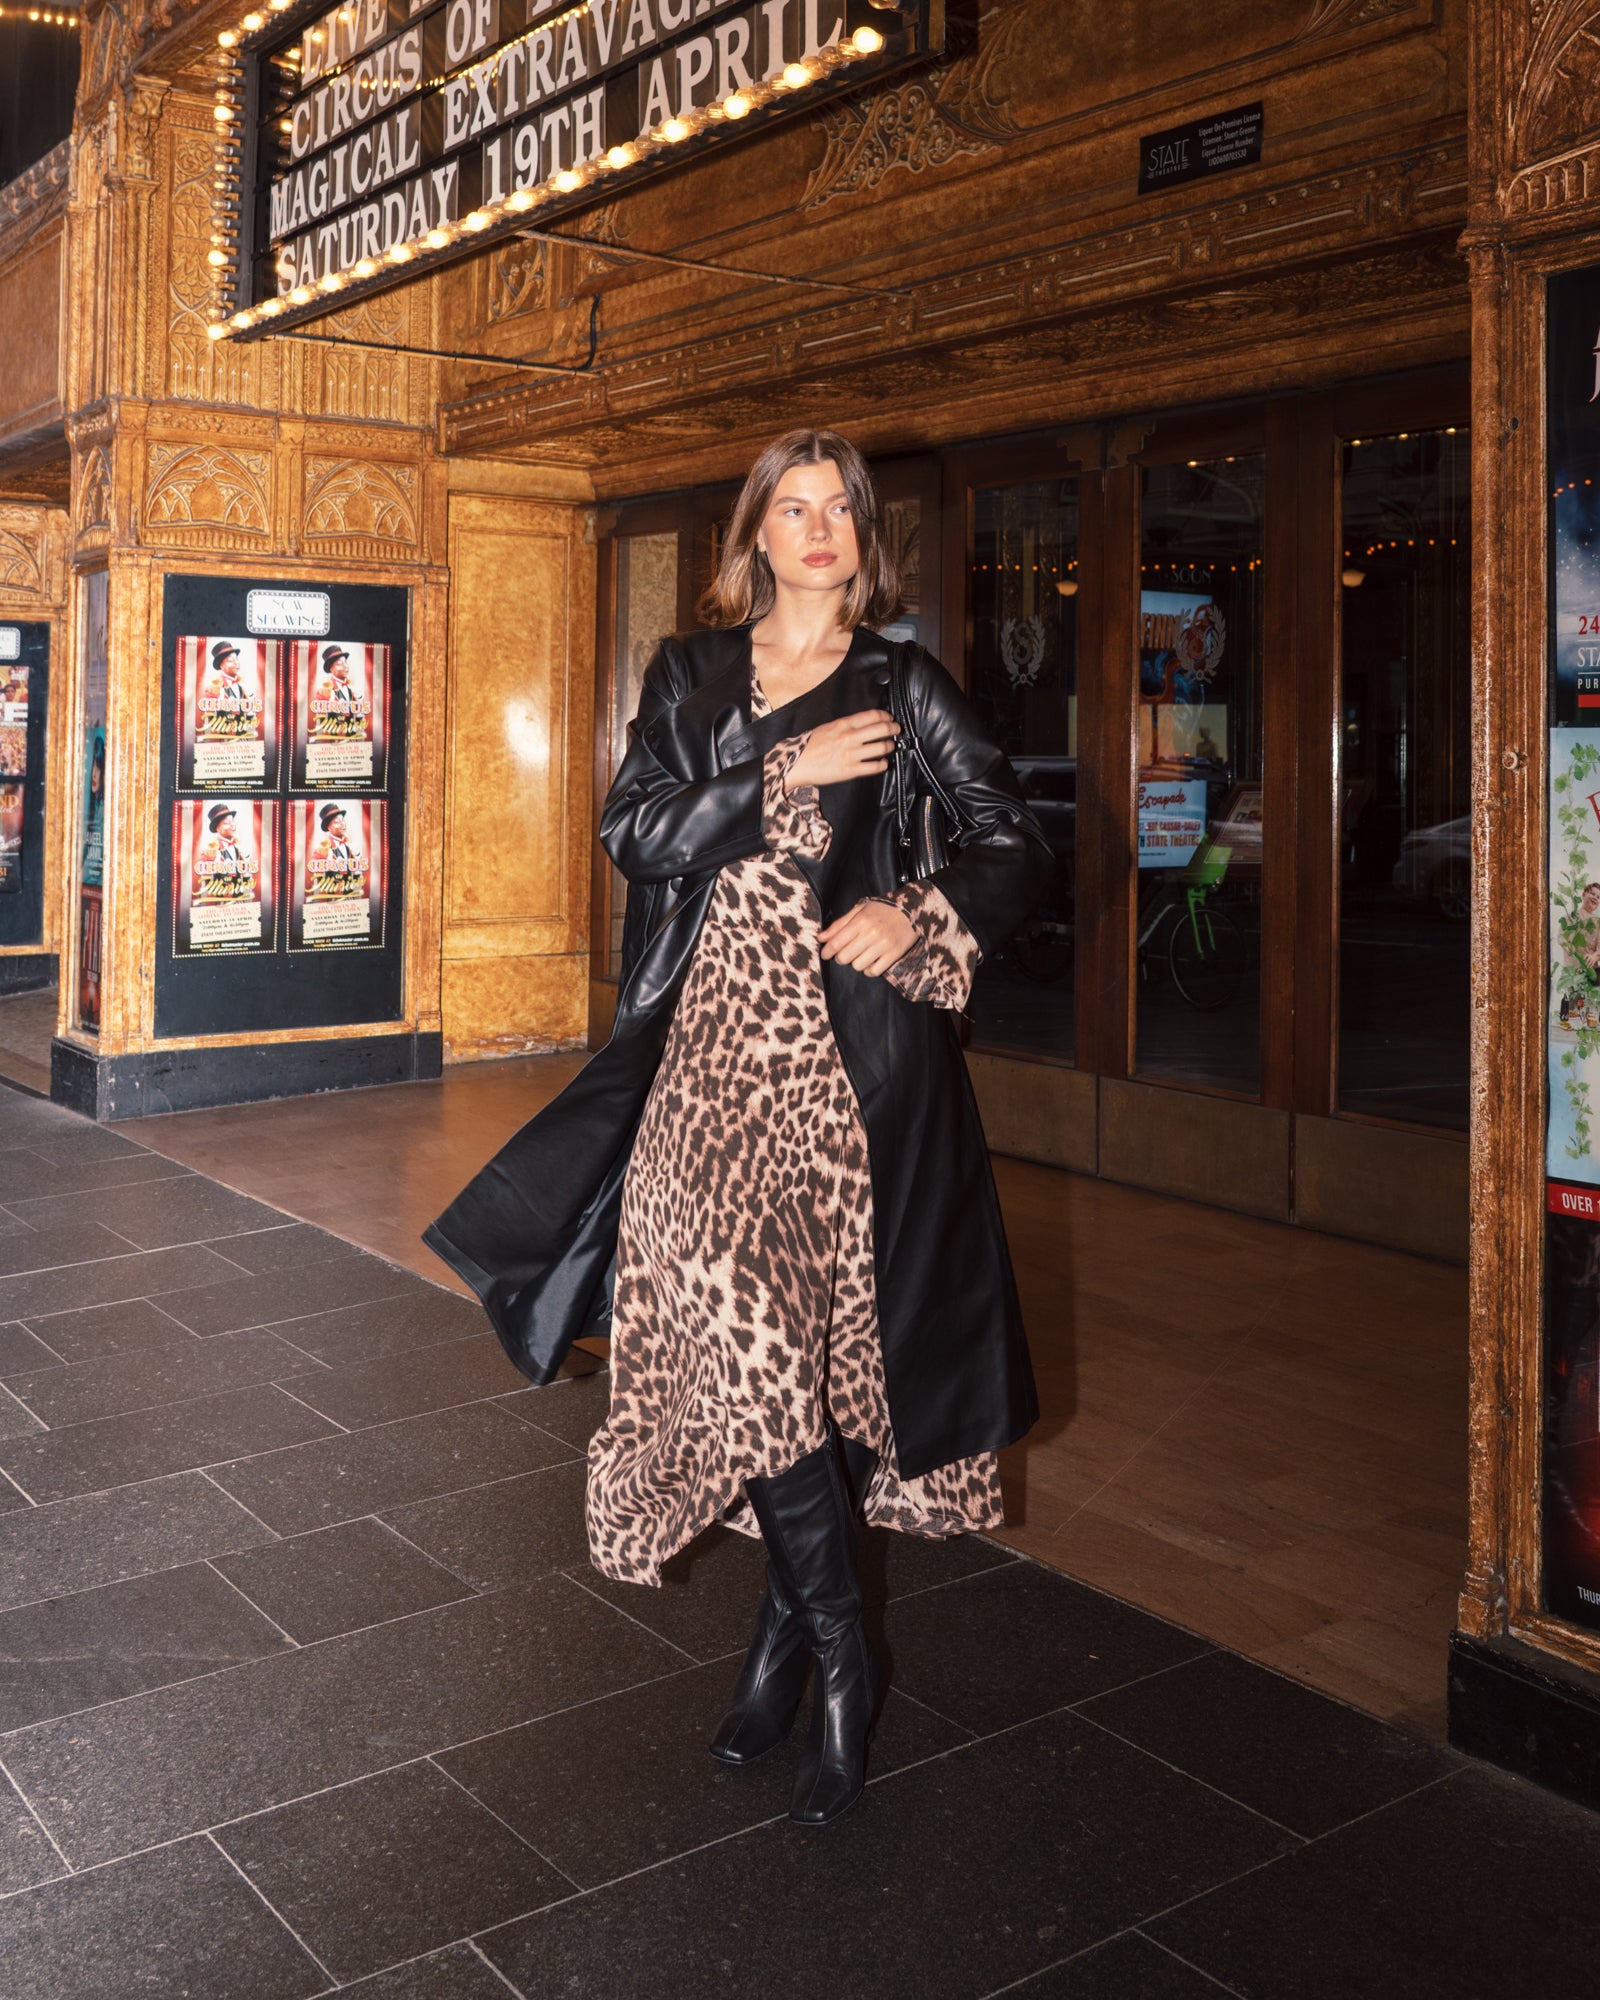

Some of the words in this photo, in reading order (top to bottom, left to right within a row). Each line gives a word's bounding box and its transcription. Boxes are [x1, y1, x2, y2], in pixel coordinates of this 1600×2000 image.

[302, 0, 387, 88] LIVE
[292, 29, 421, 158] CIRCUS
[446, 0, 491, 63] OF
[270, 109, 419, 239] MAGICAL
[444, 0, 732, 148] EXTRAVA
[278, 162, 457, 297] SATURDAY
[486, 87, 604, 206] 19TH
[640, 0, 843, 134] APRIL
[1147, 138, 1190, 171] STATE
[1577, 678, 1600, 690] PUR
[198, 699, 262, 712] CIRCUS
[310, 700, 371, 714] CIRCUS
[1139, 785, 1186, 810] Escapade
[1147, 834, 1168, 848] STATE
[194, 860, 259, 875] CIRCUS
[307, 858, 369, 872] CIRCUS
[1561, 1192, 1594, 1214] OVER
